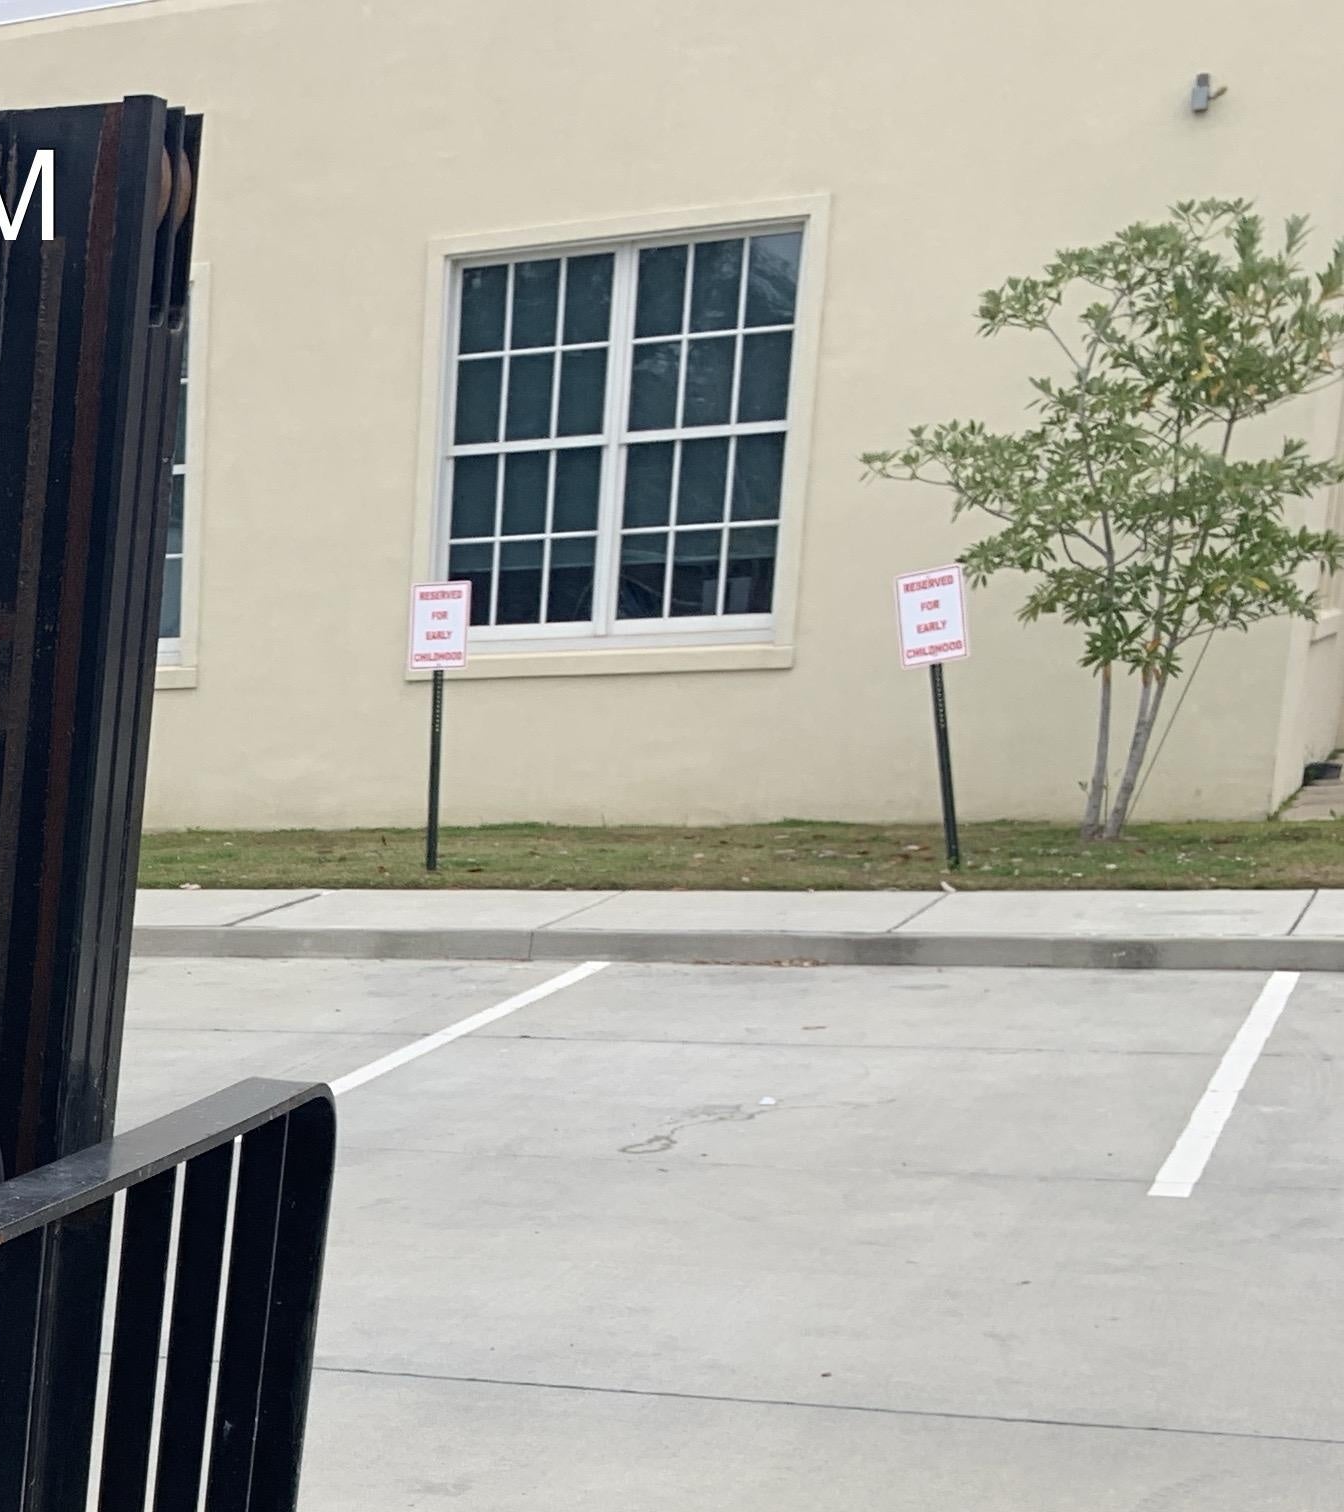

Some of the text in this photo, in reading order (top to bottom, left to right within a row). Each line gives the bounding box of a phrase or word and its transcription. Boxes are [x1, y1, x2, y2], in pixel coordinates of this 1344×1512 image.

[903, 574, 954, 594] RESERVED
[419, 589, 463, 601] RESERVED
[920, 599, 940, 612] FOR
[431, 610, 449, 620] FOR
[916, 619, 948, 634] EARLY
[425, 630, 453, 641] EARLY
[906, 639, 963, 659] CHILDHOOD
[414, 651, 463, 662] CHILDHOOD
